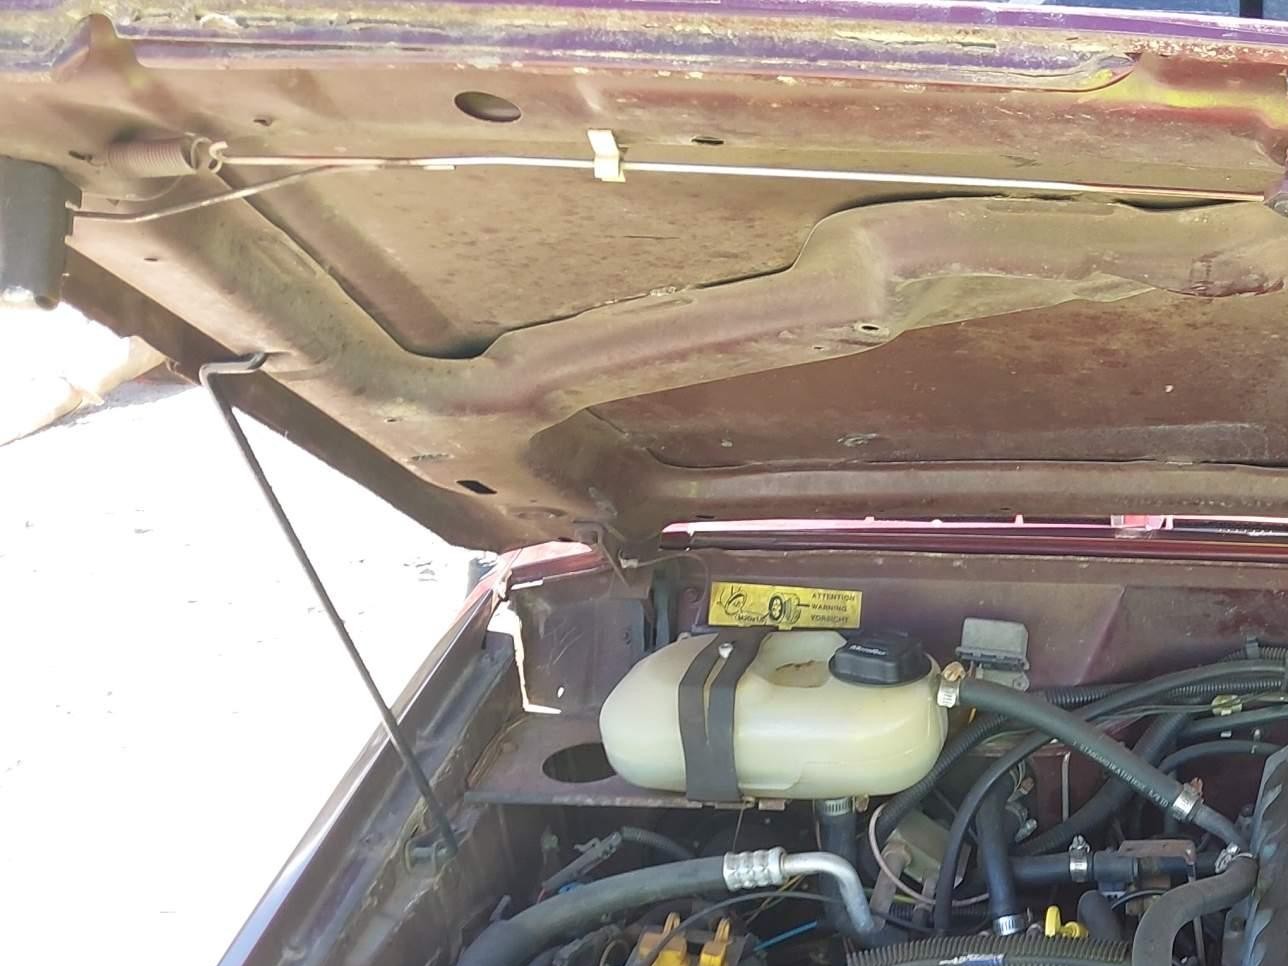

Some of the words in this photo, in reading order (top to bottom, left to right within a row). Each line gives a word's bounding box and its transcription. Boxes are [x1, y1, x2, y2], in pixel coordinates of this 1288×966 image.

[811, 592, 856, 602] ATTENTION
[811, 603, 848, 612] WARNING
[810, 614, 849, 624] VORSICHT
